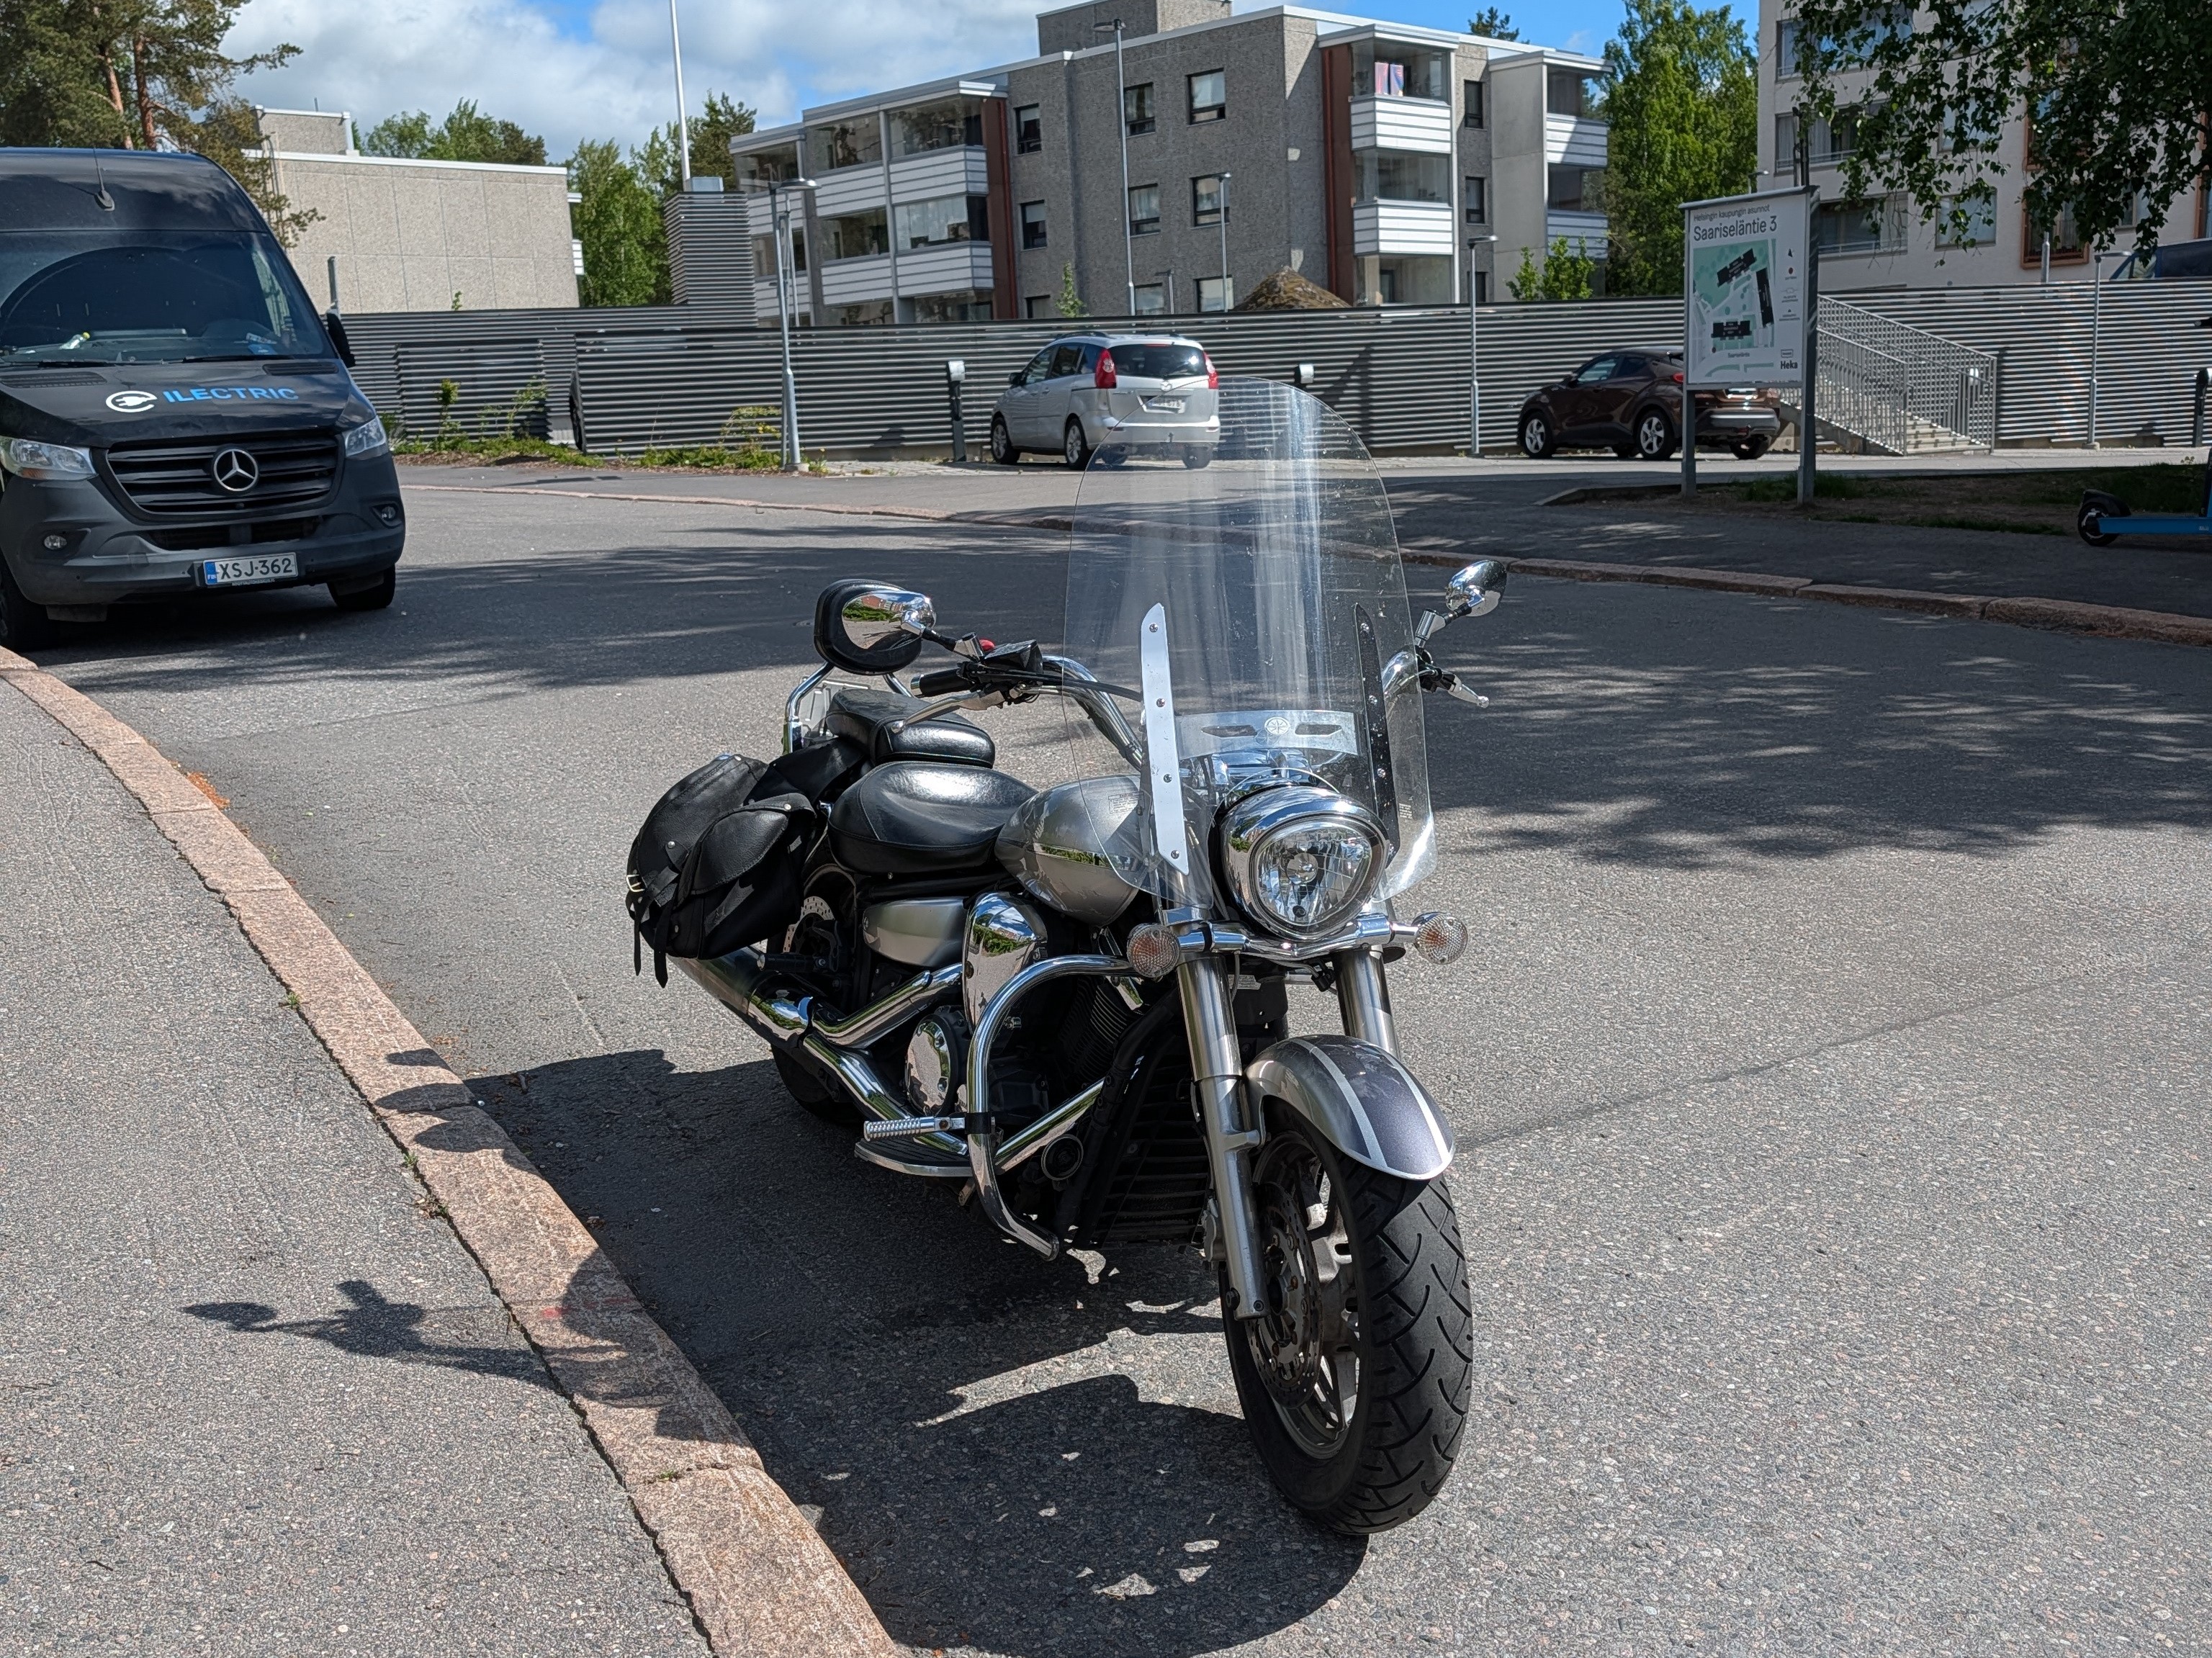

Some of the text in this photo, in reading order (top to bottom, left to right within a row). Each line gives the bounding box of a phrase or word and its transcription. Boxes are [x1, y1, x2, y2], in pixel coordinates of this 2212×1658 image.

[1719, 209, 1747, 218] kaupungin
[1748, 204, 1771, 215] asunnot
[1694, 215, 1777, 241] Saariseläntie 3
[1780, 360, 1798, 369] Heka
[163, 387, 299, 403] ILECTRIC
